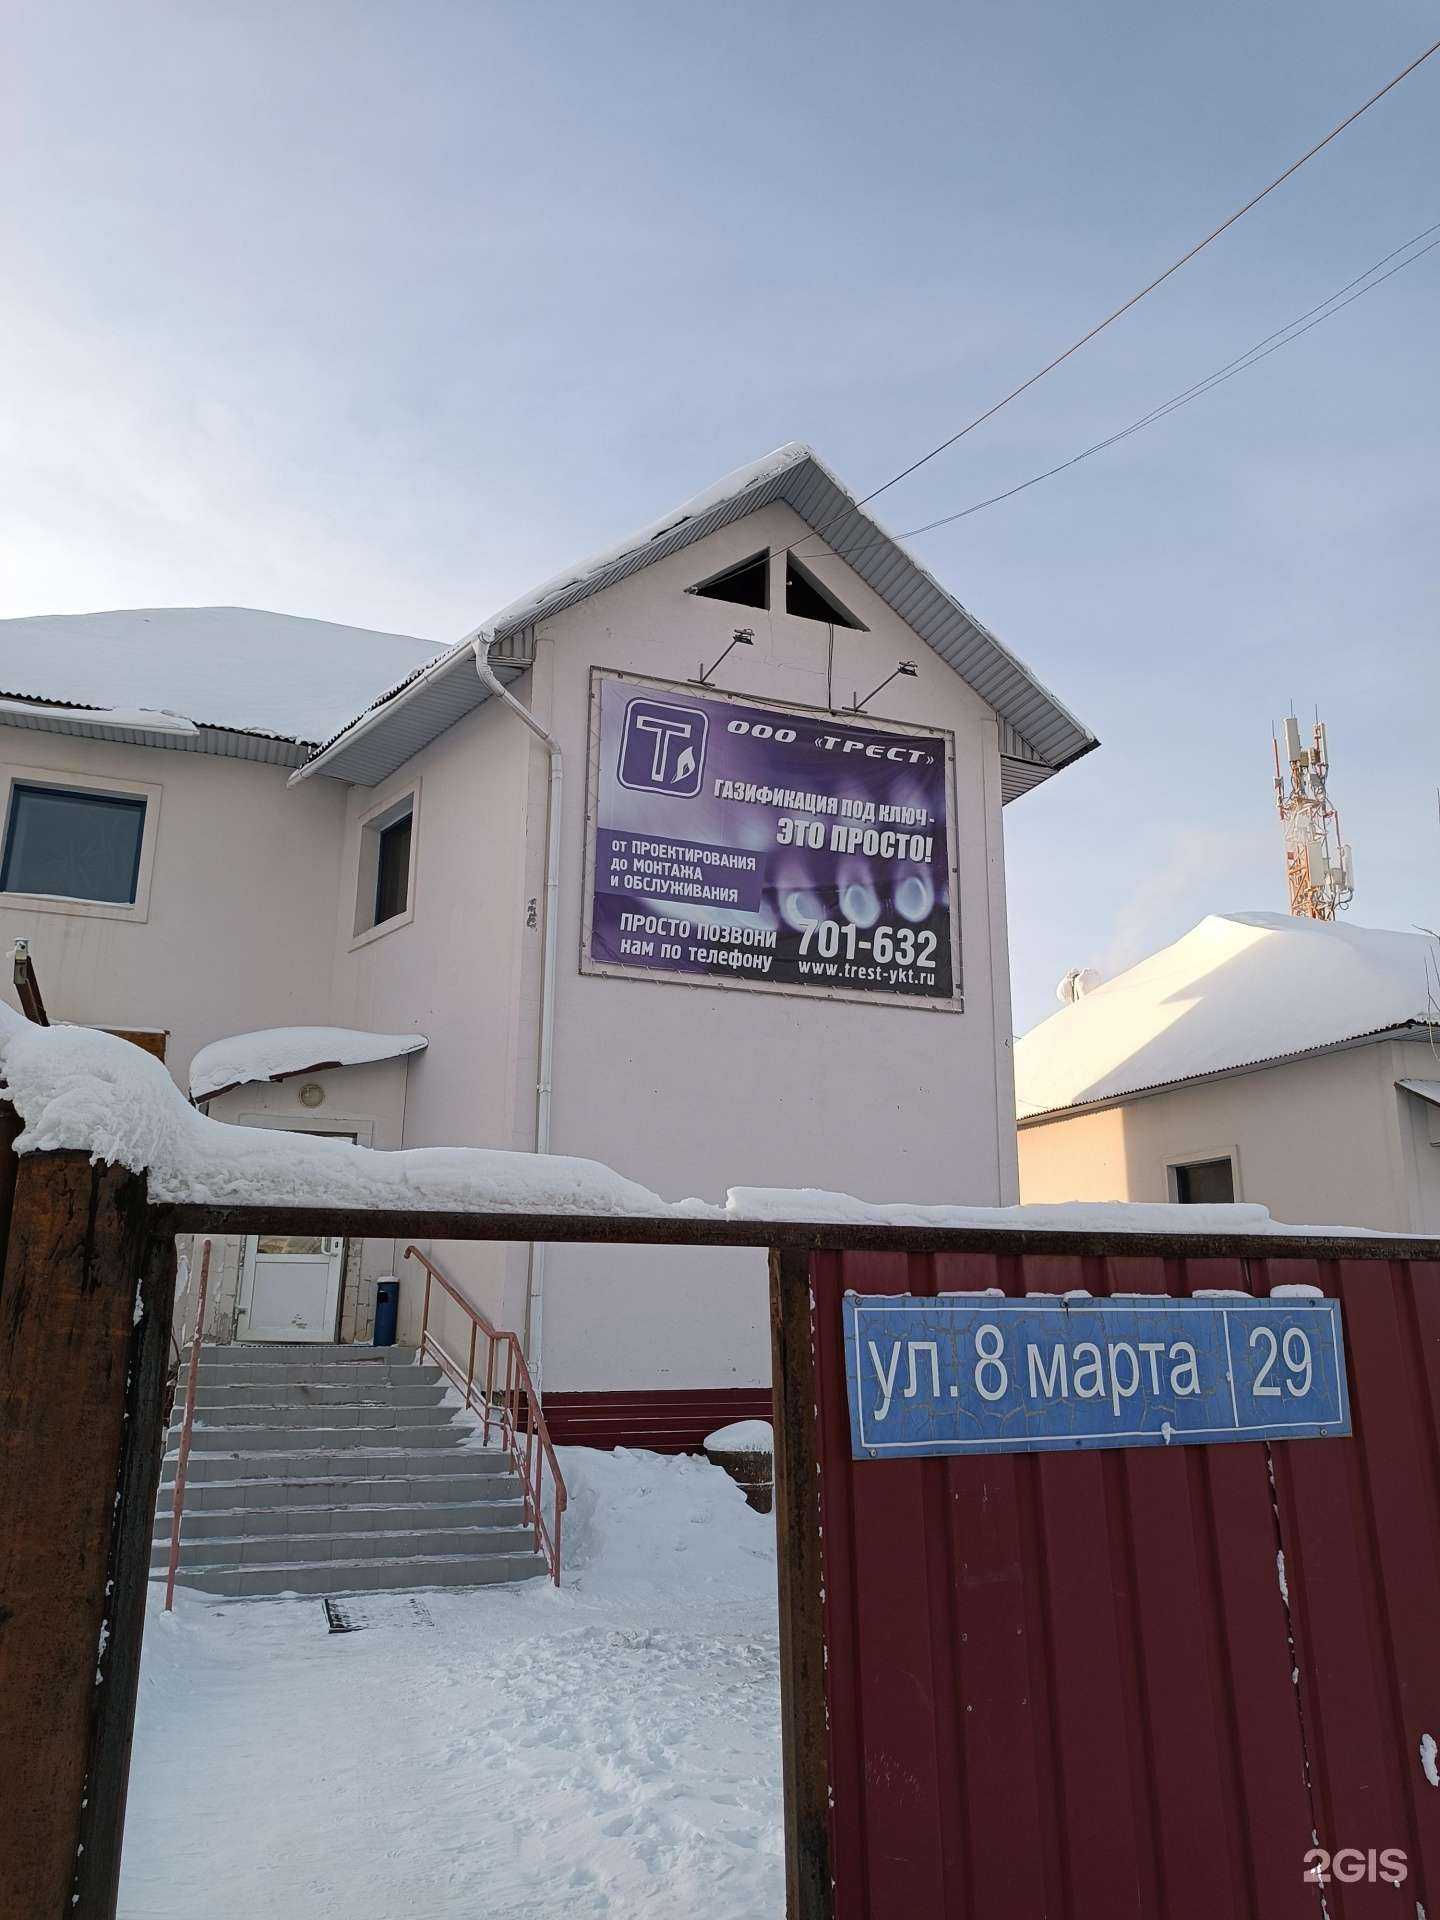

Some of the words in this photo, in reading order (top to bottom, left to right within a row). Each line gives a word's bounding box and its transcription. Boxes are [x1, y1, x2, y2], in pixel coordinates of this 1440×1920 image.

[727, 720, 797, 743] ООО
[814, 735, 935, 765] «ТРЕСТ»
[713, 779, 839, 816] ГАЗИФИКАЦИЯ
[840, 798, 876, 823] ПОД
[631, 840, 757, 871] ПРОЕКТИРОВАНИЯ
[776, 817, 826, 849] ЭТО
[830, 825, 934, 863] ПРОСТО!
[633, 858, 703, 881] МОНТАЖА
[624, 874, 739, 903] ОБСЛУЖИВАНИЯ
[620, 913, 691, 938] ПРОСТО
[696, 923, 777, 949] ПОЗВОНИ
[798, 918, 938, 968] 701-632
[620, 939, 654, 956] нам
[660, 943, 682, 960] по
[688, 946, 773, 973] телефону
[798, 960, 936, 986] www.trest-ykt.ru
[867, 1338, 960, 1421] ул.
[974, 1322, 1009, 1401] 8
[1026, 1340, 1201, 1417] марта
[1248, 1325, 1314, 1397] 29
